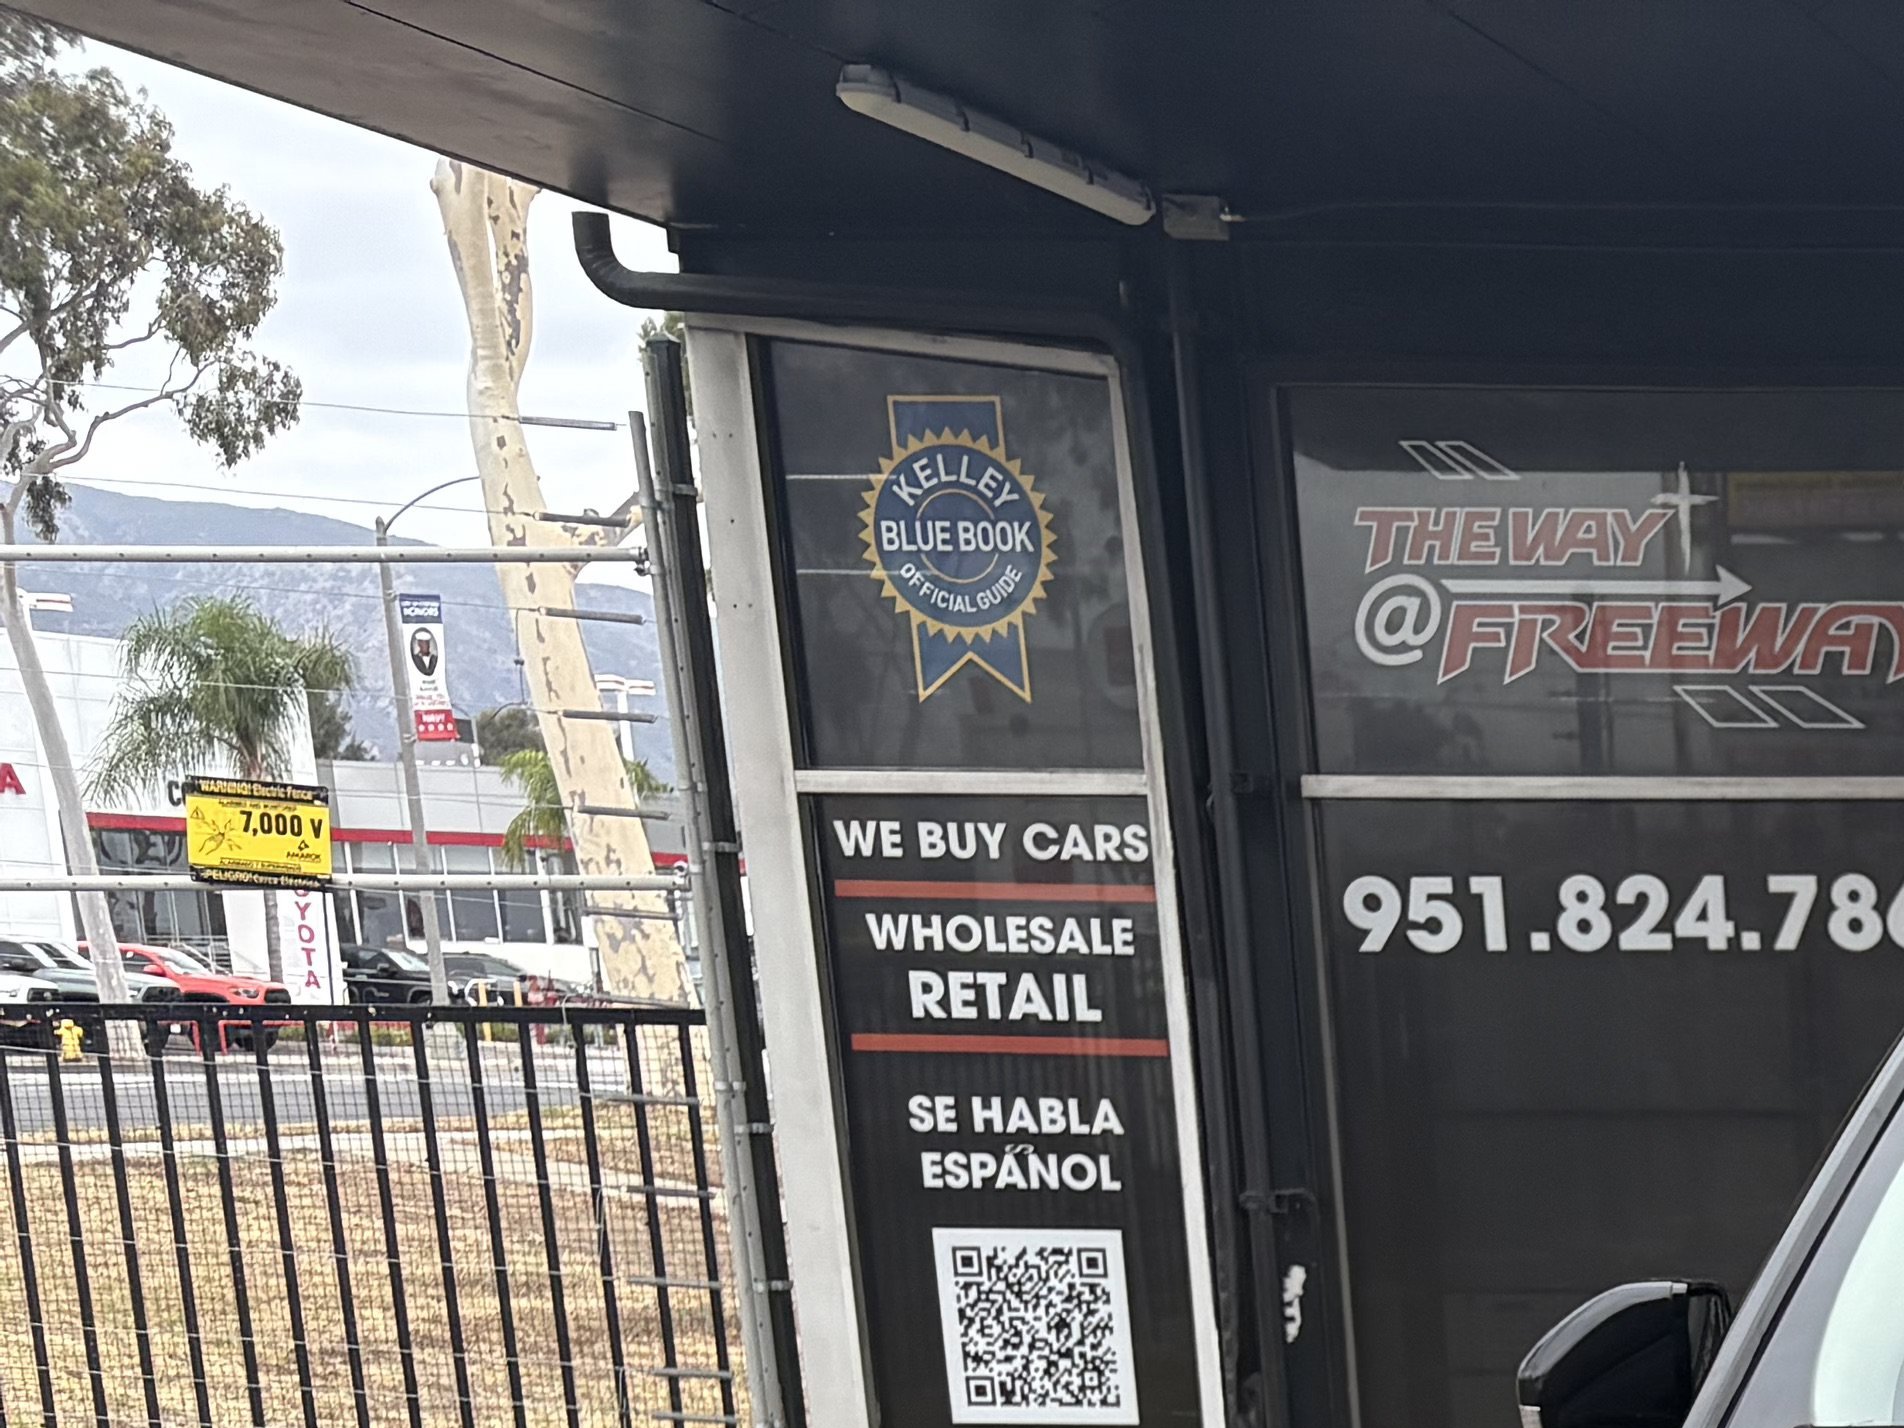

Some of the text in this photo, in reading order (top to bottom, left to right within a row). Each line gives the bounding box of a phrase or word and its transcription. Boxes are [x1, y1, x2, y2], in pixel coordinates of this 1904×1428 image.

[892, 454, 1020, 508] KELLEY
[880, 519, 1035, 554] BLUE BOOK
[1354, 506, 1673, 574] THE WAY
[898, 561, 1025, 614] OFFICIAL GUIDE
[240, 810, 323, 839] 7,000 V
[833, 819, 1150, 864] WE BUY CARS
[865, 913, 1136, 957] WHOLESALE
[908, 970, 1102, 1023] RETAIL
[908, 1095, 1125, 1136] SE HABLA
